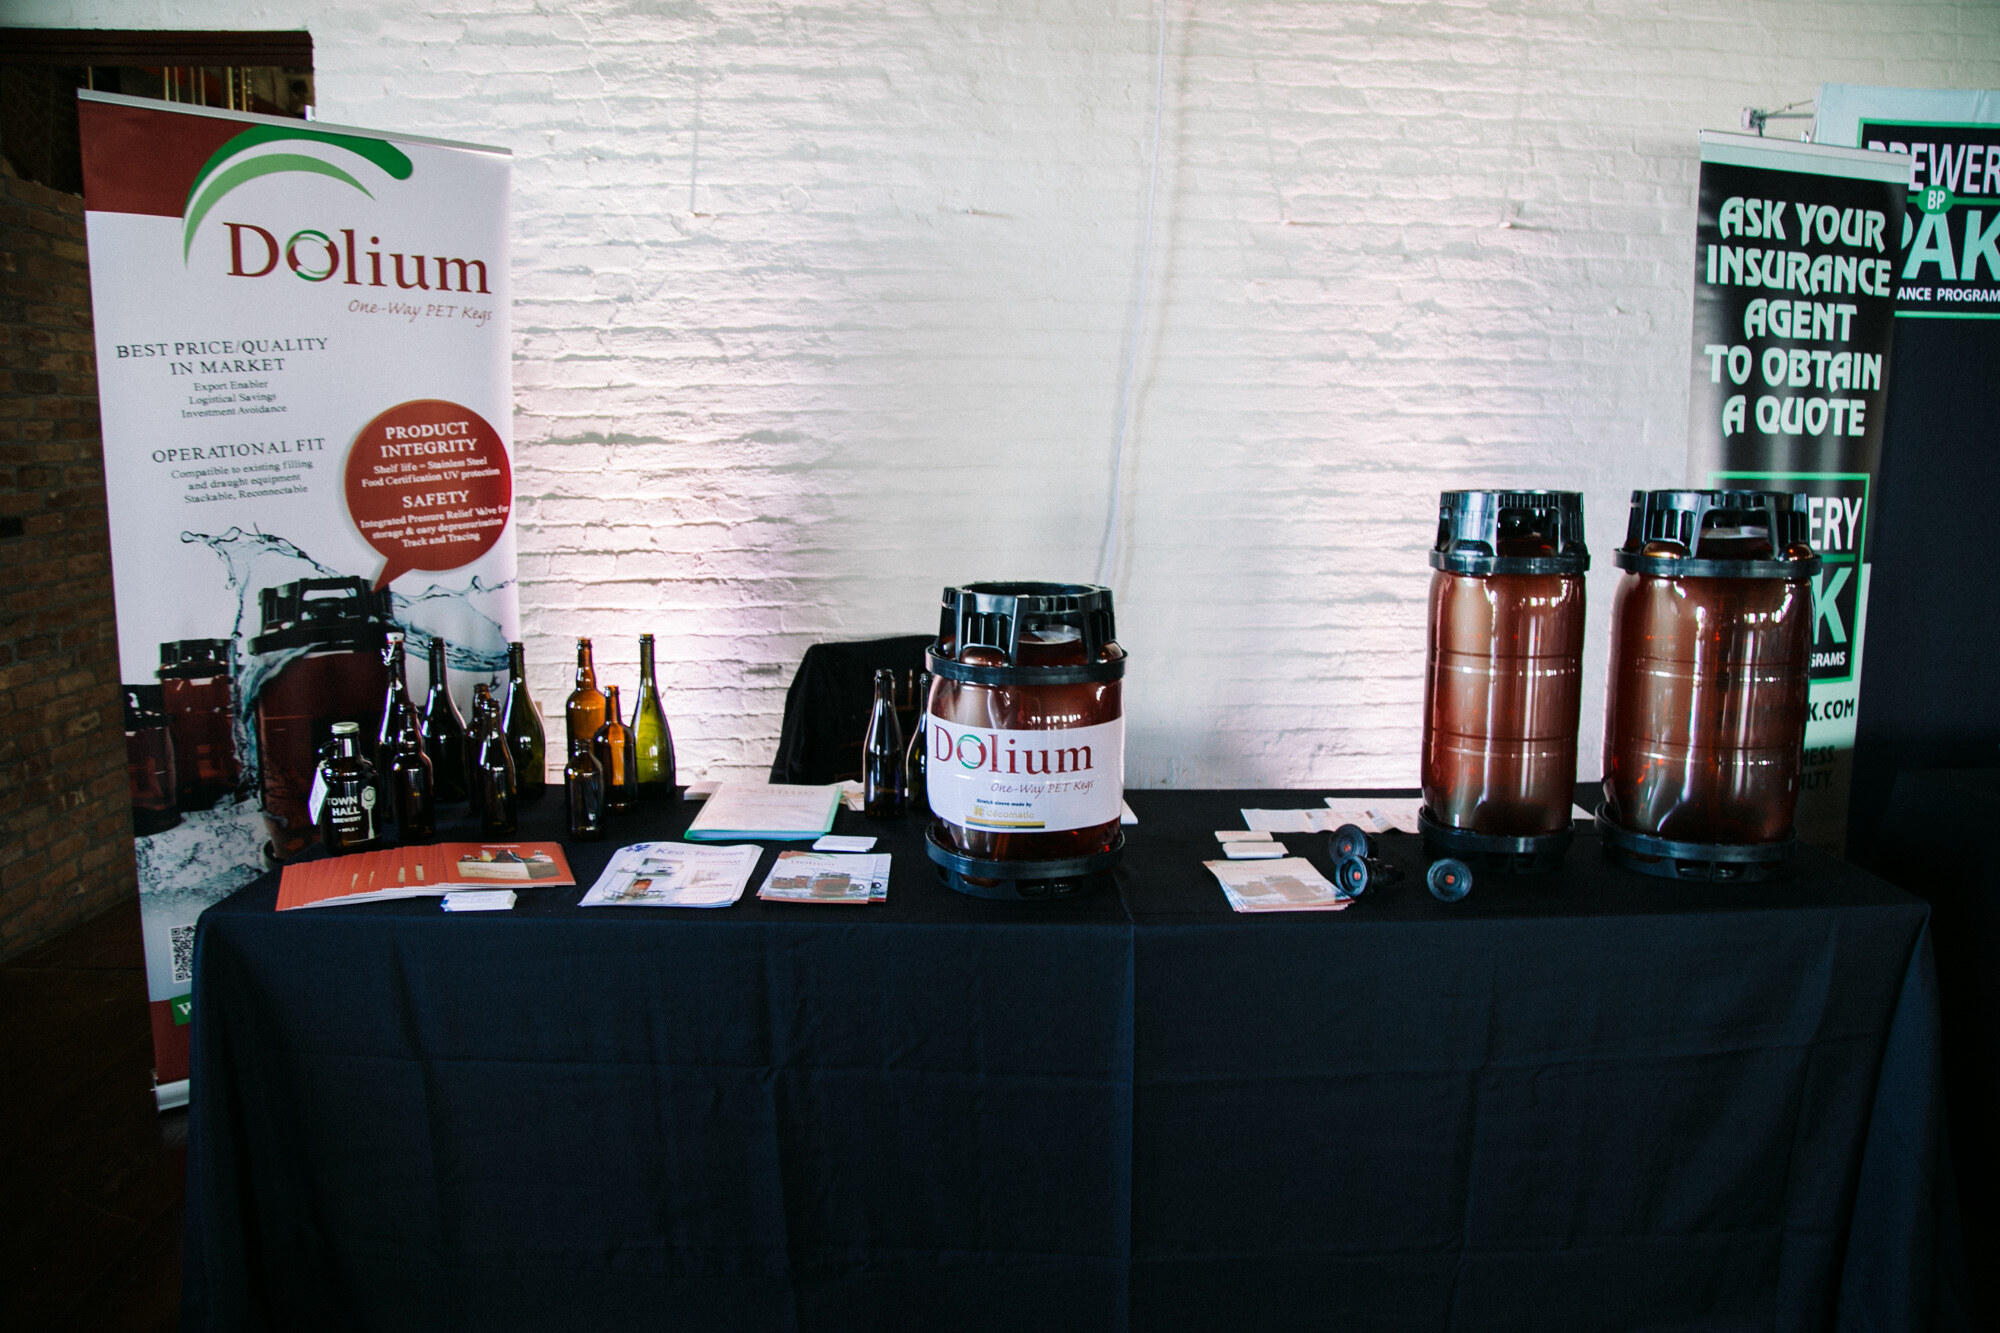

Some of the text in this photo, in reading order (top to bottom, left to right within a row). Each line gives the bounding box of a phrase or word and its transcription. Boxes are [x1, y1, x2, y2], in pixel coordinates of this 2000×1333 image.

[1926, 189, 1947, 210] BP
[1718, 196, 1887, 254] ASK YOUR
[222, 221, 492, 295] Dolium
[1706, 244, 1892, 298] INSURANCE
[347, 299, 493, 328] One-Way PET Kegs
[1743, 298, 1858, 342] AGENT
[115, 337, 329, 358] BEST PRICE/QUALITY
[170, 358, 285, 375] IN MARKET
[1704, 344, 1883, 393] TO OBTAIN
[193, 379, 268, 393] Export Enabler
[189, 391, 277, 406] Logistical Savings
[181, 404, 288, 419] Investment Avoidance
[1722, 394, 1866, 438] A QUOTE
[385, 421, 469, 440] PRODUCT
[152, 437, 326, 463] OPERATIONAL FIT
[380, 438, 478, 459] INTEGRITY
[171, 459, 313, 480] Compatible to existing filling
[373, 463, 398, 474] Shelf
[400, 462, 418, 472] life
[427, 459, 466, 470] Stainless
[466, 456, 488, 466] Steel
[188, 472, 301, 490] and draught equipment
[362, 467, 500, 488] Food Certification UV protection
[238, 485, 308, 499] Reconnectable
[402, 490, 470, 509] SAFETY
[360, 505, 509, 529] Integrated Pressure Relief Valve for
[372, 529, 404, 540] storage
[405, 526, 415, 536] &
[416, 525, 436, 535] easy
[401, 531, 481, 548] Track and Tracing
[934, 723, 1094, 775] Dolium
[990, 779, 1095, 799] One-Way PET Kegs
[326, 795, 358, 806] TOWN
[332, 806, 361, 816] HALL
